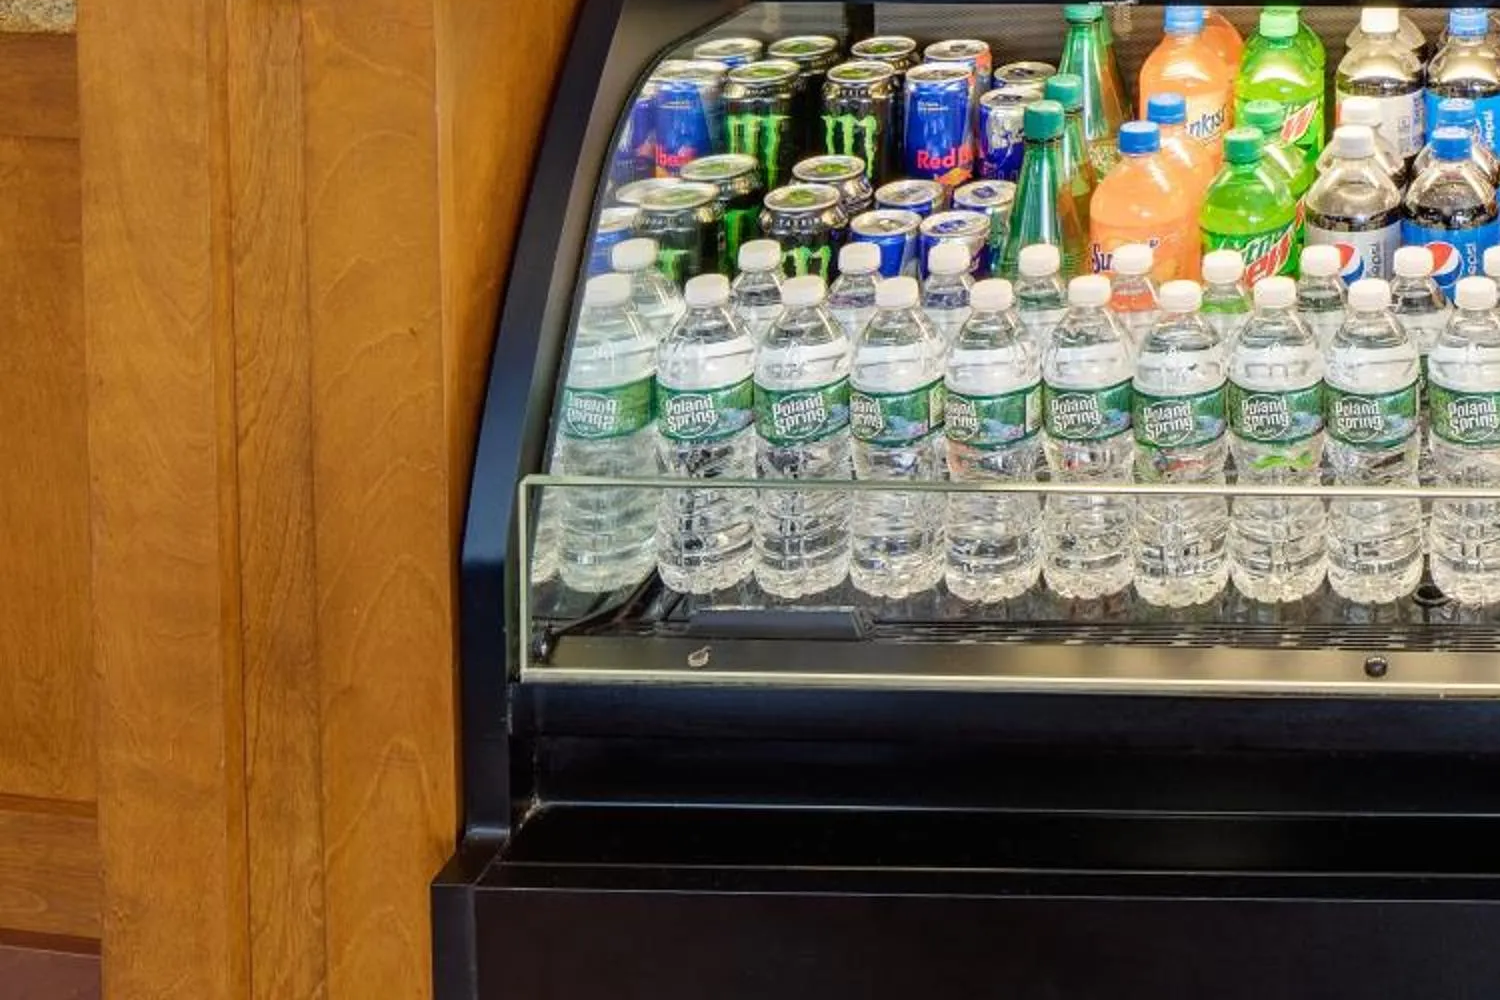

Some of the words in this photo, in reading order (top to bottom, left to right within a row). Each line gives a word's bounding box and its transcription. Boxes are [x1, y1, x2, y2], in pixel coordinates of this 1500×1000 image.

[916, 147, 958, 170] Red
[666, 394, 713, 416] Poland
[773, 392, 824, 420] Poland
[1052, 393, 1098, 414] Poland
[1144, 400, 1192, 423] Poland
[1242, 398, 1287, 417] Poland
[1336, 399, 1382, 420] Poland
[1448, 399, 1498, 421] Poland
[667, 409, 717, 433] Spring
[776, 407, 826, 434] Spring
[1054, 408, 1101, 431] Spring
[1146, 416, 1193, 441] Spring
[1243, 413, 1289, 435] Spring
[1338, 415, 1384, 437] Spring
[1450, 416, 1500, 439] Spring
